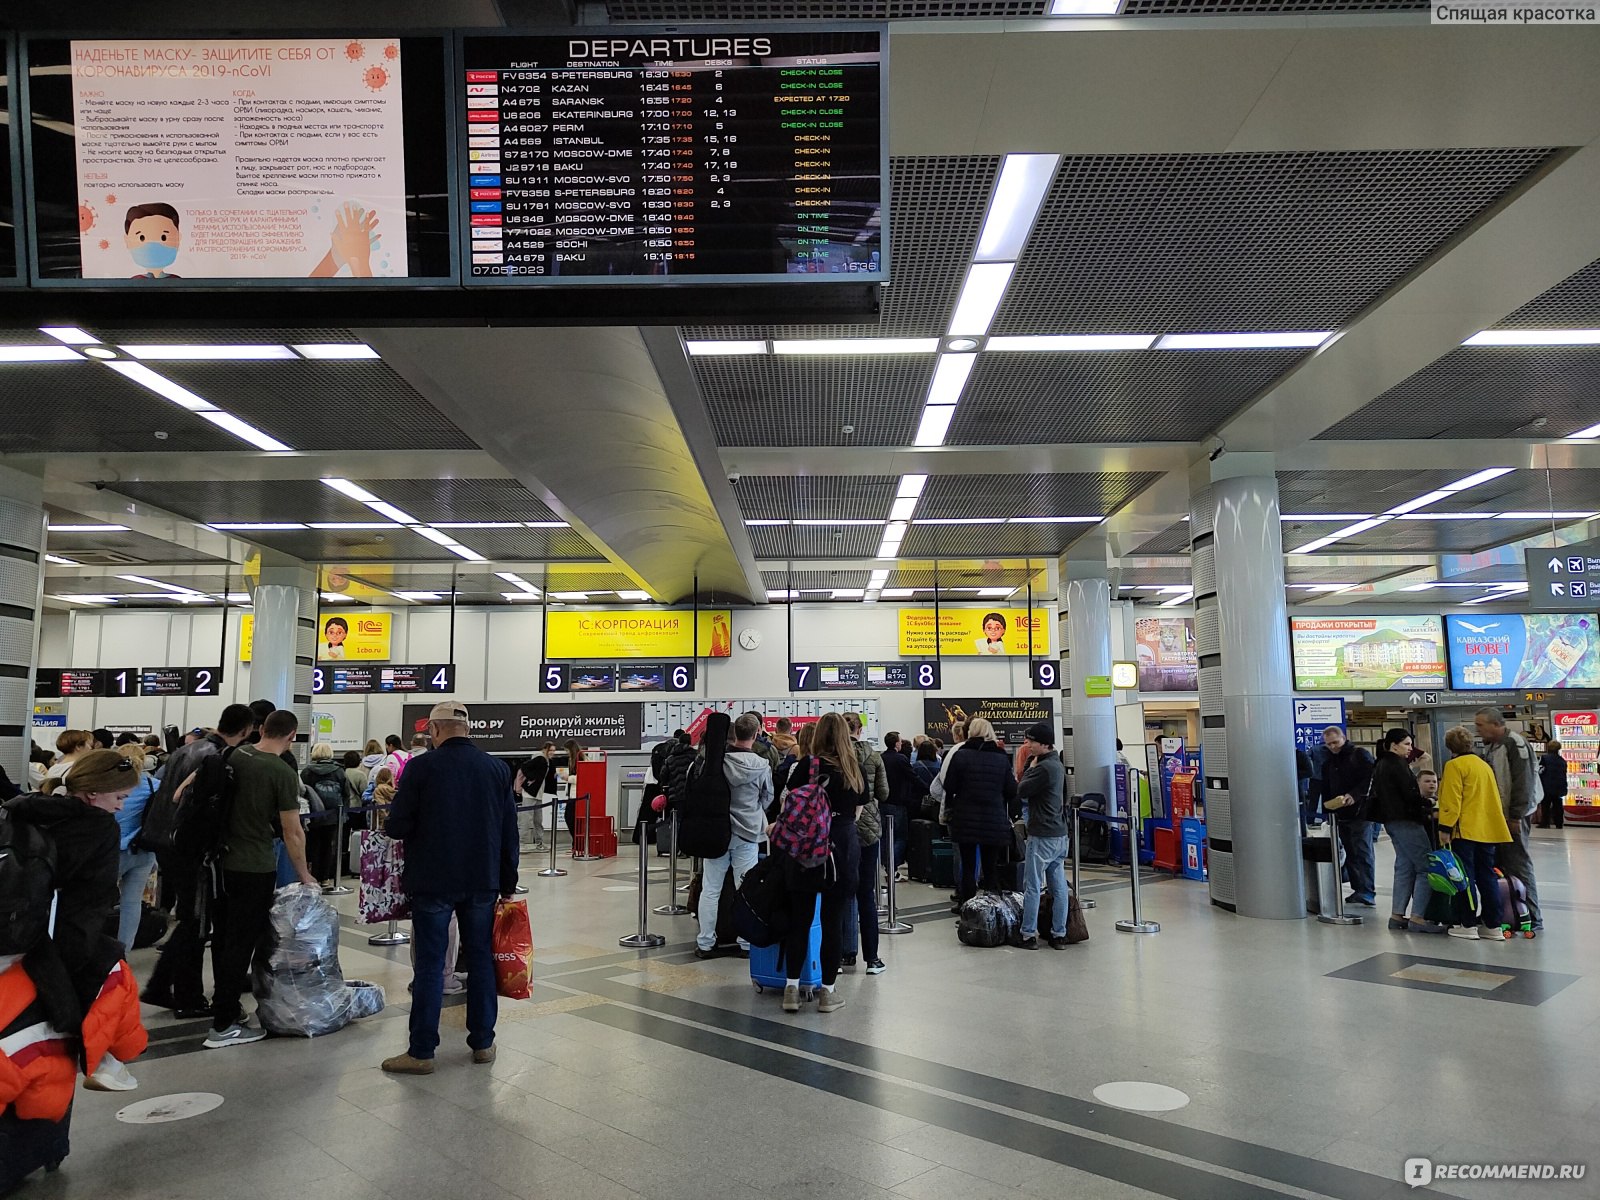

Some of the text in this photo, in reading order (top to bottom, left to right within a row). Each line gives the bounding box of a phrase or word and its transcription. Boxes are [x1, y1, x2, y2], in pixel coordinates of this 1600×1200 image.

[76, 49, 138, 62] НАДЕНЬТЕ
[202, 48, 272, 62] ЗАЩИТИТЕ
[278, 48, 311, 60] СЕБЯ
[316, 48, 335, 60] ОТ
[569, 38, 772, 58] DEPARTURES
[76, 65, 187, 78] КОРОНАВИРУСА
[641, 162, 670, 170] 17:40
[579, 620, 679, 630] 1С:КОРПОРАЦИЯ
[1456, 635, 1510, 643] КАВКАЗСКИЙ
[1466, 644, 1509, 654] БЮВЕТ
[116, 671, 126, 694] 1
[195, 670, 212, 692] 2
[313, 669, 324, 691] 3
[432, 668, 448, 689] 4
[546, 667, 561, 689] 5
[672, 666, 688, 688] 6
[796, 666, 810, 688] 7
[919, 665, 934, 686] 8
[1039, 664, 1056, 686] 9
[981, 700, 1039, 710] Хороший друг
[520, 714, 625, 728] Бронируй жильё
[974, 711, 1048, 719] АВИАКОМПАНИИ
[520, 726, 625, 739] для путешествий
